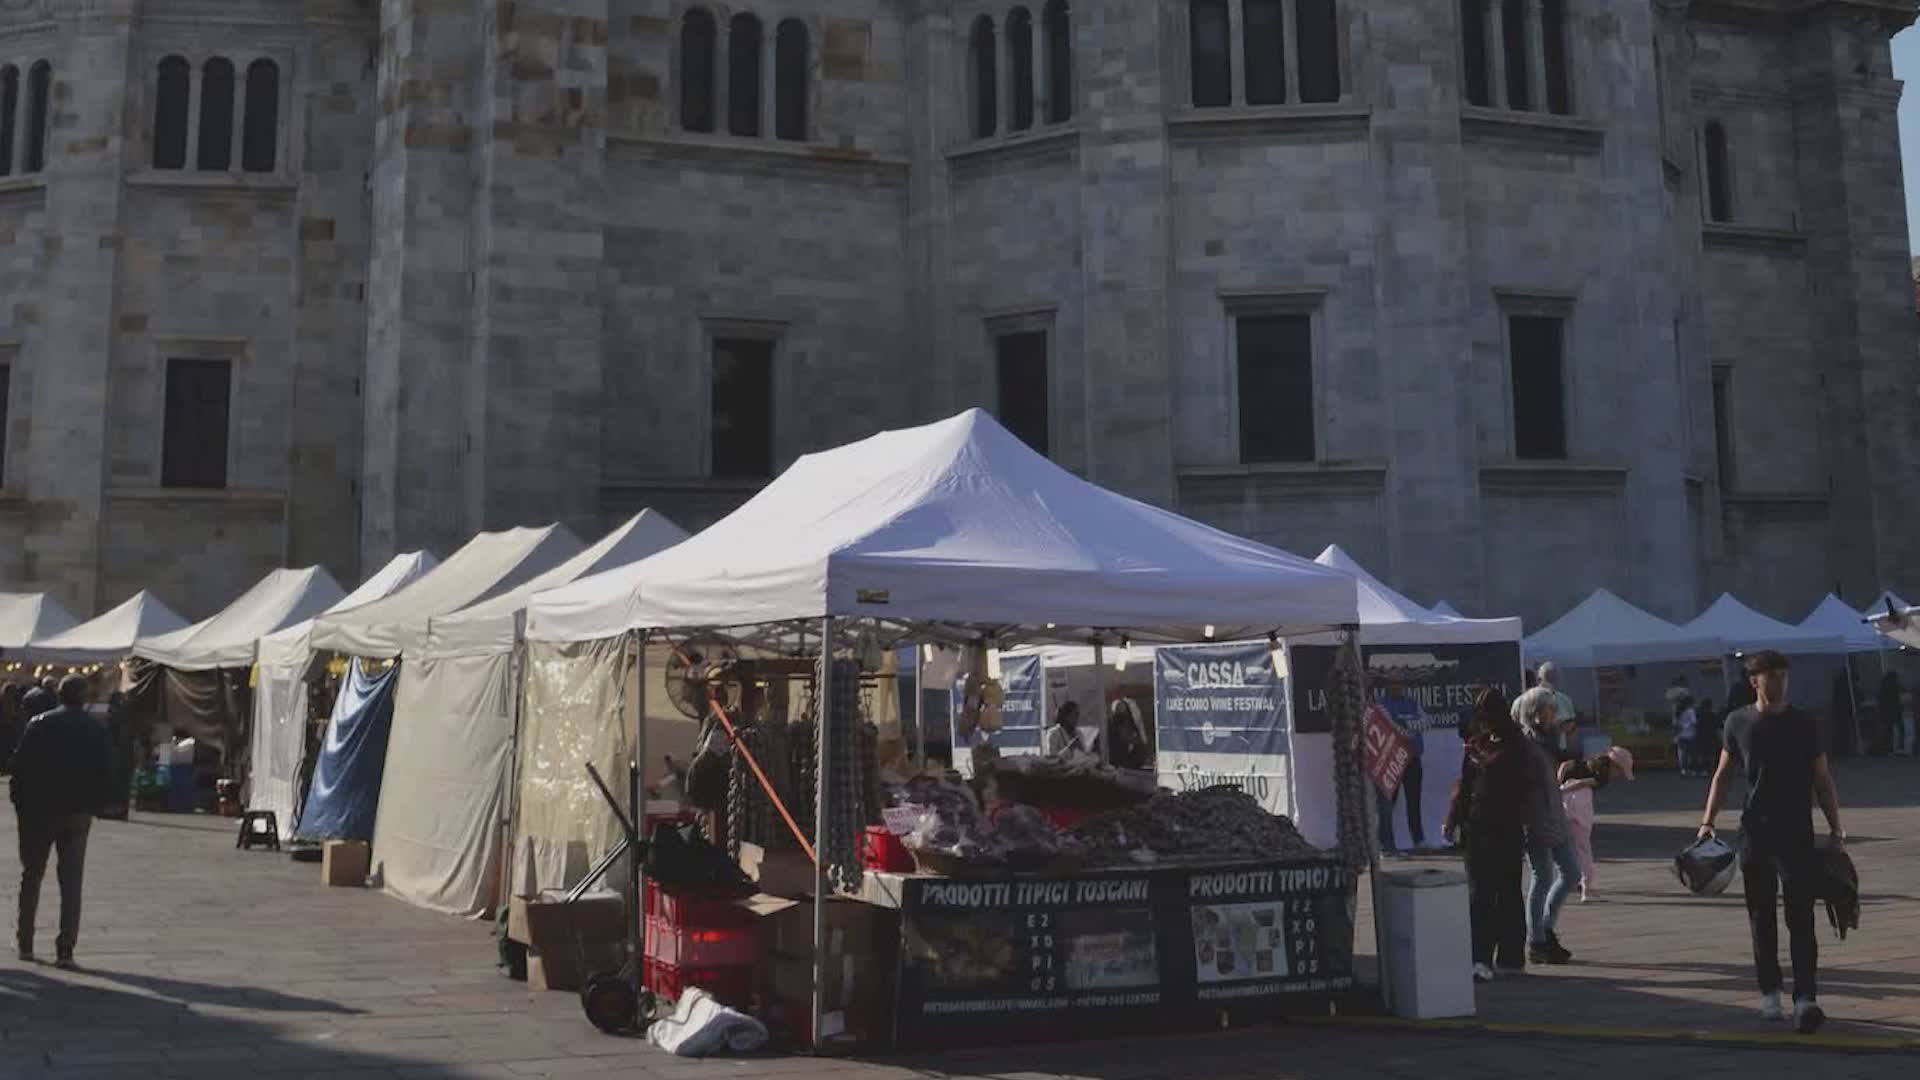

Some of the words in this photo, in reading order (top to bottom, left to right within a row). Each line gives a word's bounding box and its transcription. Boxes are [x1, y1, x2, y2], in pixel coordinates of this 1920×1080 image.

[1187, 661, 1244, 686] CASSA
[1185, 698, 1209, 711] COMO
[1210, 697, 1233, 711] WINE
[1234, 697, 1275, 711] FESTIVAL
[921, 881, 1010, 907] PRODOTTI
[1017, 881, 1070, 905] TIPICI
[1075, 879, 1150, 902] TOSCANI
[1189, 872, 1274, 897] PRODOTTI
[1279, 867, 1329, 894] TIPICI
